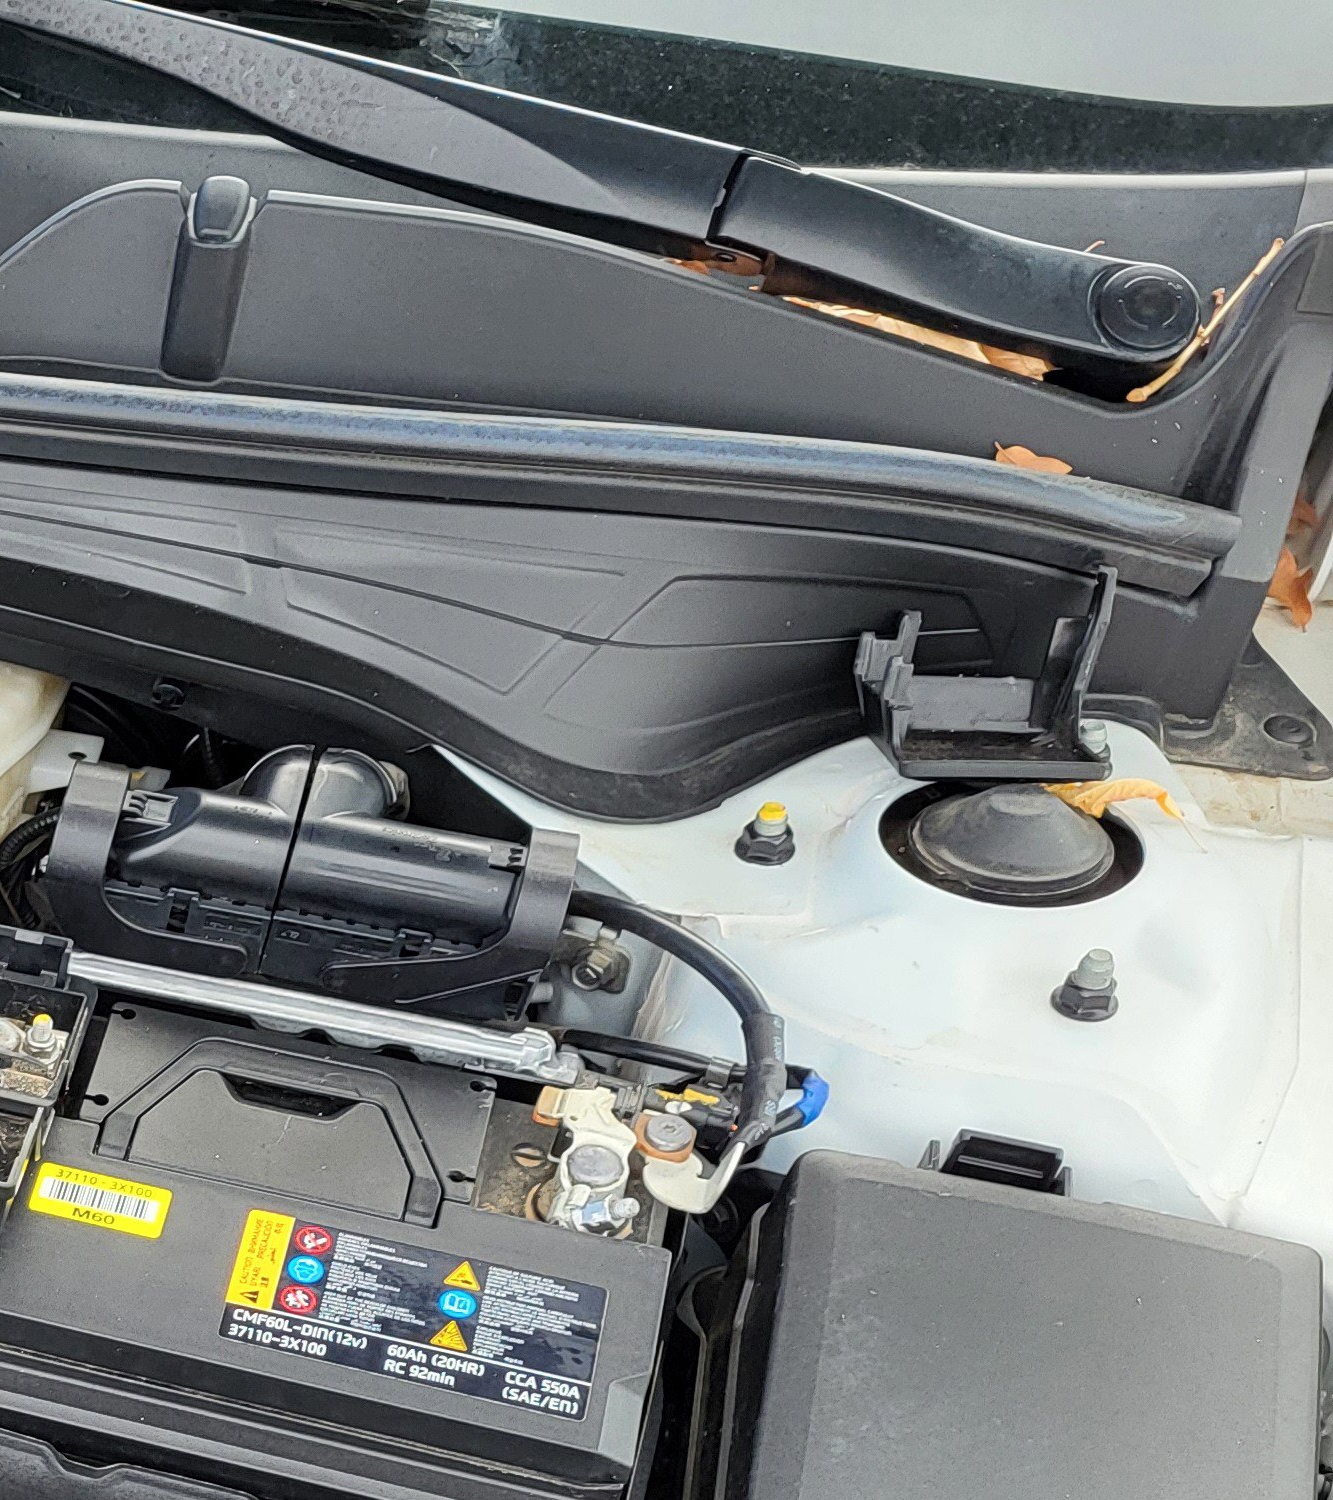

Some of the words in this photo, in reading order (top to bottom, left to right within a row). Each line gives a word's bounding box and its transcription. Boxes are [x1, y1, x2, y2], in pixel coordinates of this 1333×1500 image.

[72, 1207, 115, 1225] M60
[228, 1324, 327, 1357] 37110-3X100
[384, 1360, 407, 1376] RC
[387, 1344, 428, 1364] 60Ah
[431, 1347, 485, 1377] (20HR)
[504, 1372, 539, 1389] CCA
[541, 1379, 580, 1399] 550A
